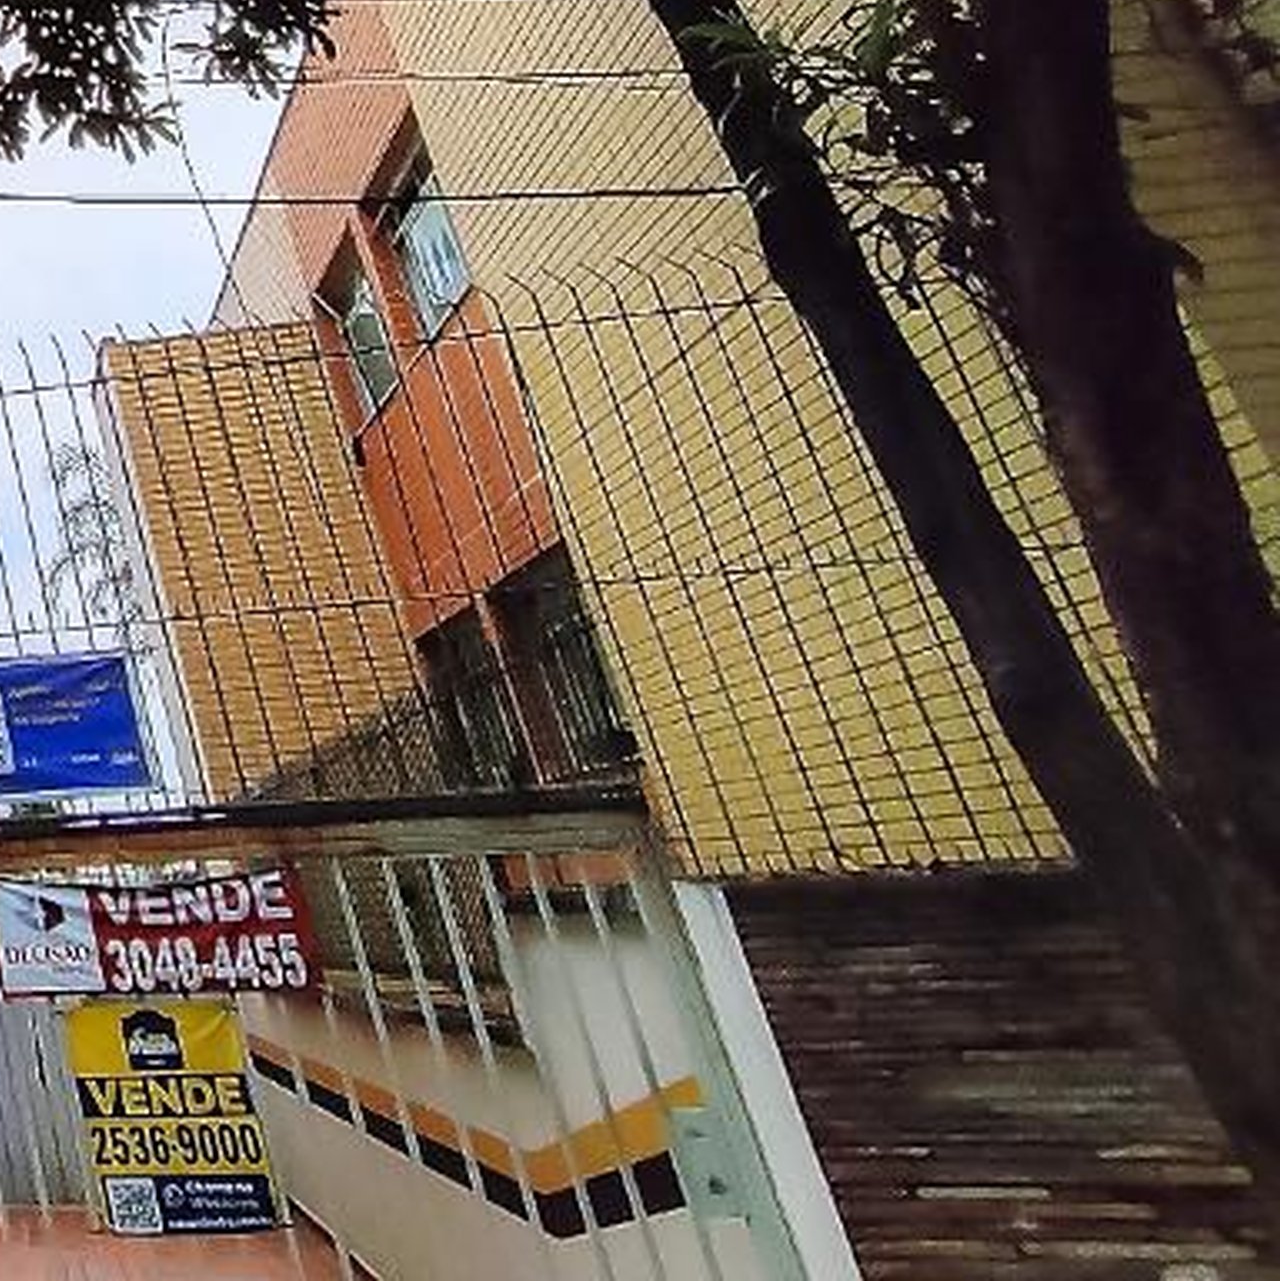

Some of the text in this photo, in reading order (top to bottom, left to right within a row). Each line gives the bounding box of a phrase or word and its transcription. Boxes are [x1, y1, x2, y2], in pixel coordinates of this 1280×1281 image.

[97, 870, 293, 926] VENDE
[104, 932, 307, 992] 3048-4455
[84, 1076, 248, 1116] VENDE
